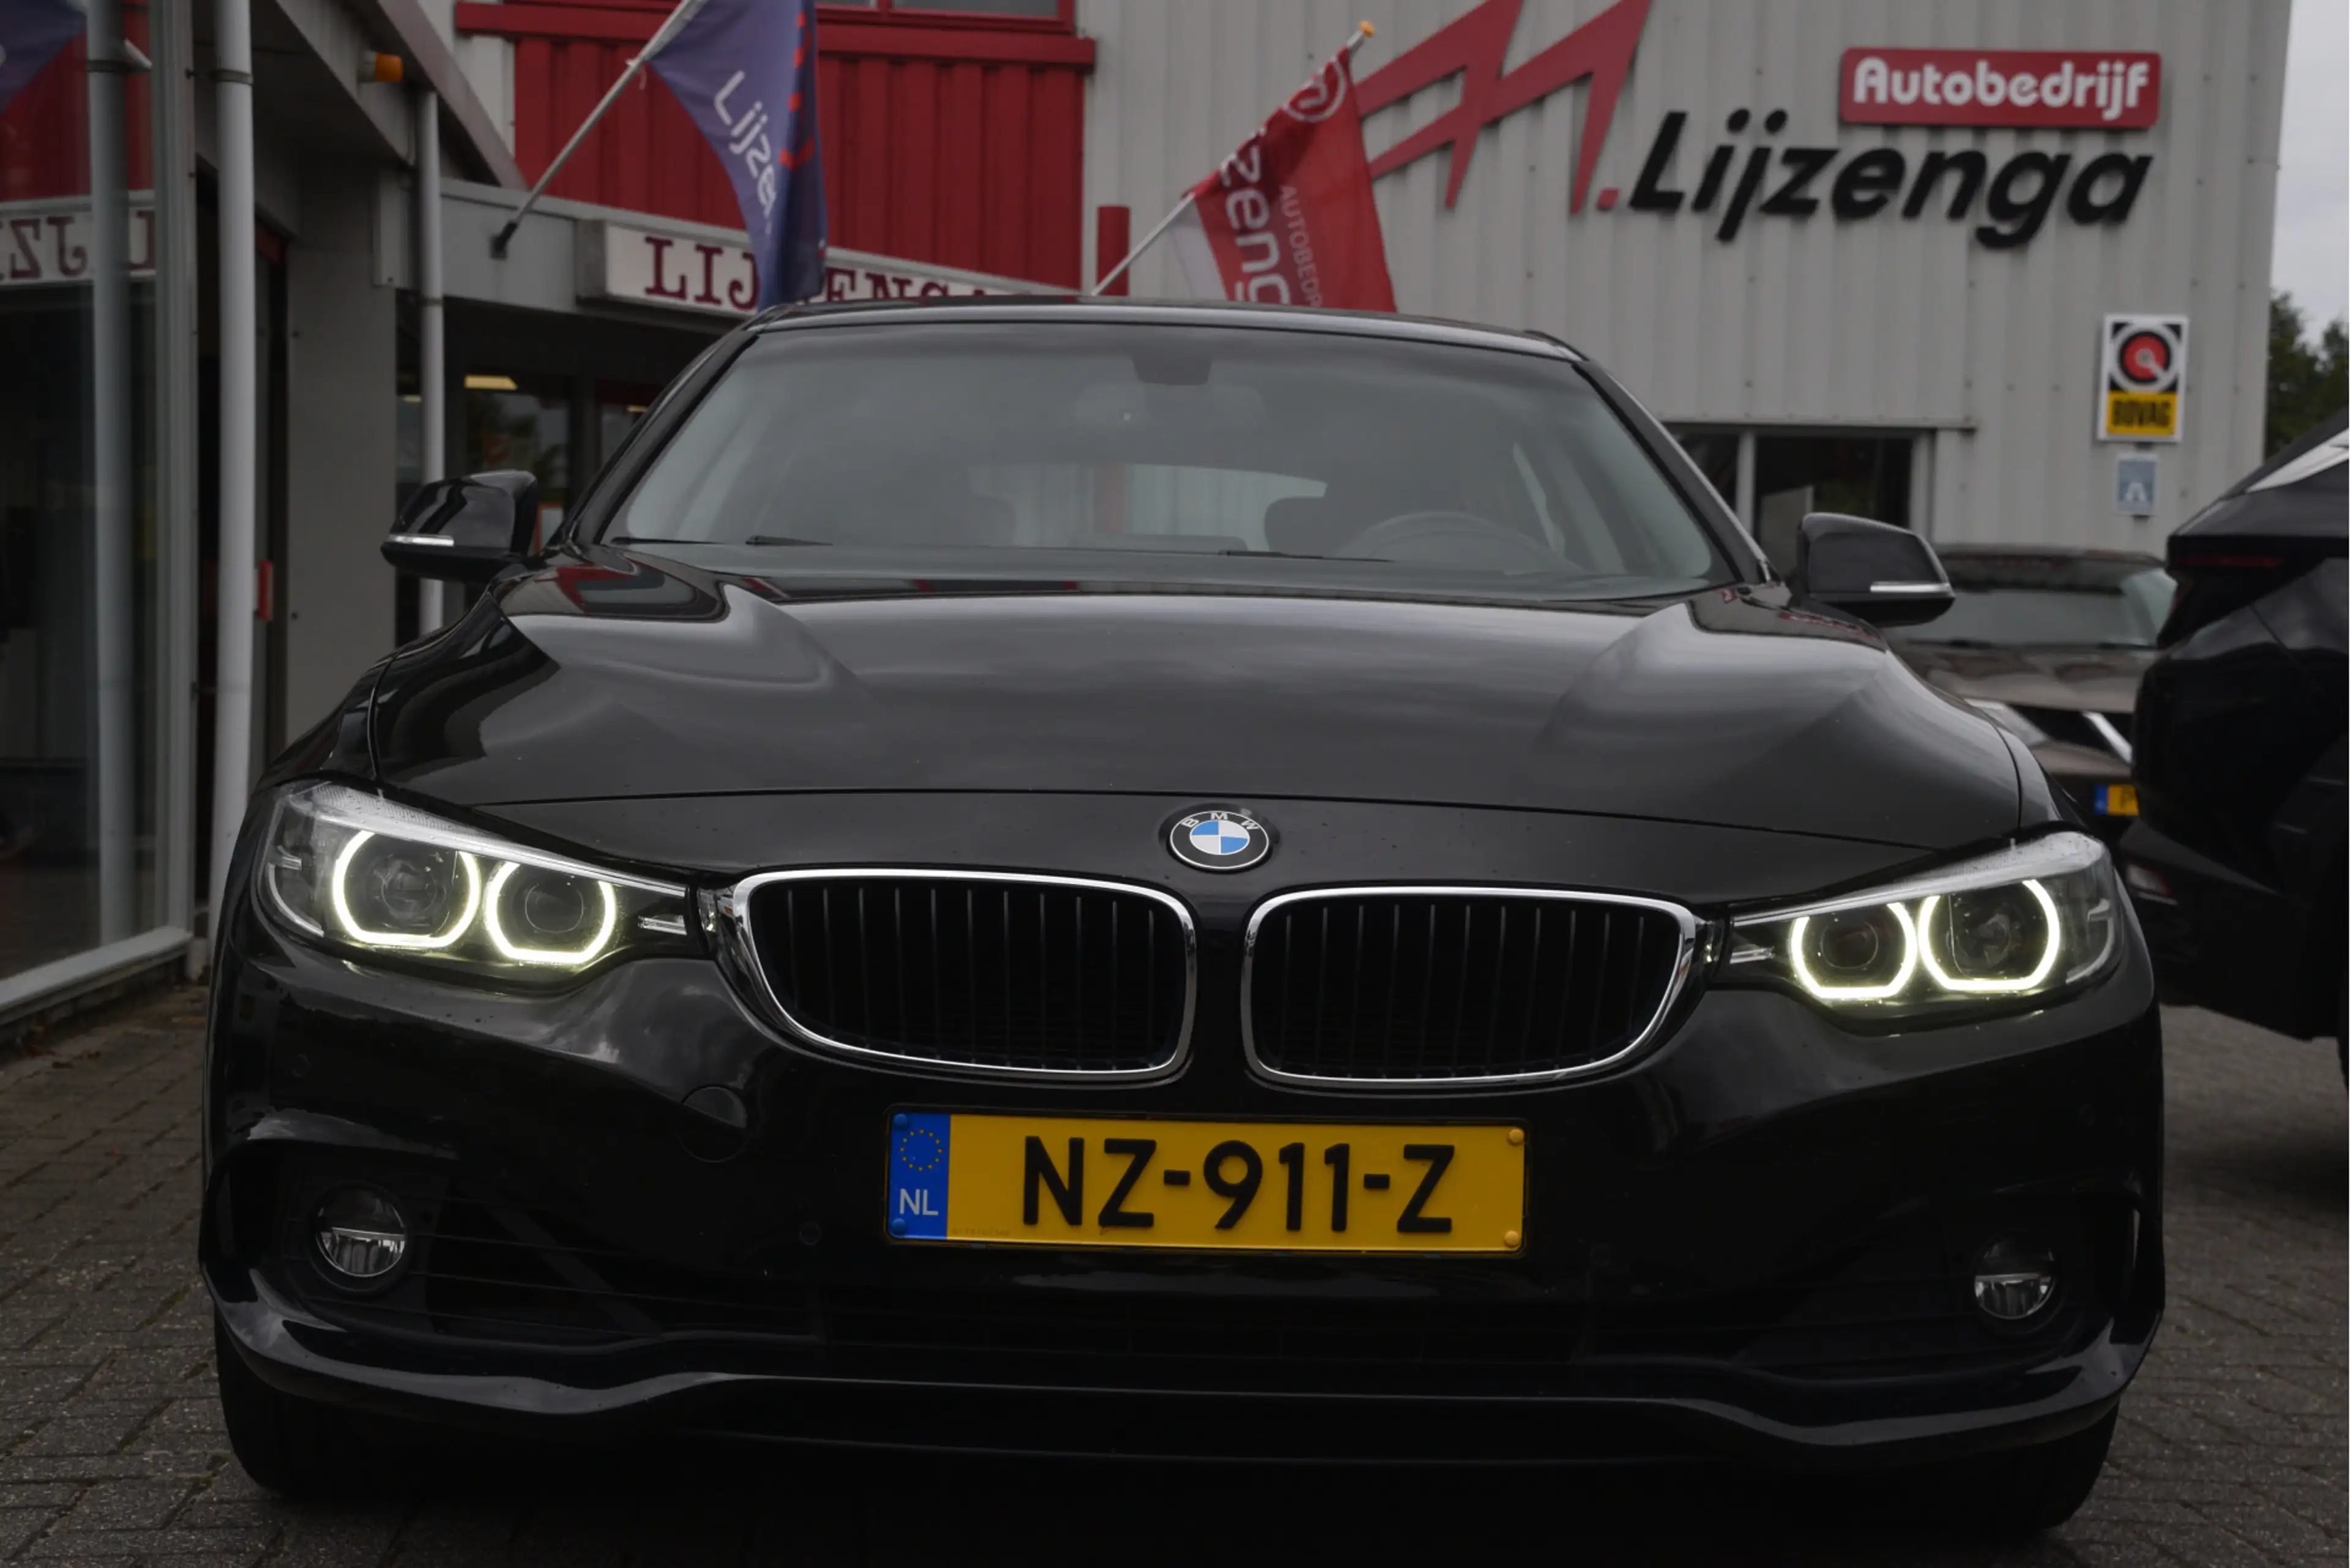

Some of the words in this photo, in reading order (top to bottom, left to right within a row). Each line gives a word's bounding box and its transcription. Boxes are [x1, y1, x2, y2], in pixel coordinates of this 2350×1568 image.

[1853, 56, 2150, 121] Autobedrijf
[713, 69, 777, 233] Lijze
[1629, 109, 2154, 247] Lijzenga
[1181, 812, 1260, 831] BMW
[899, 1188, 939, 1216] NL
[1022, 1135, 1455, 1233] NZ-911-Z
